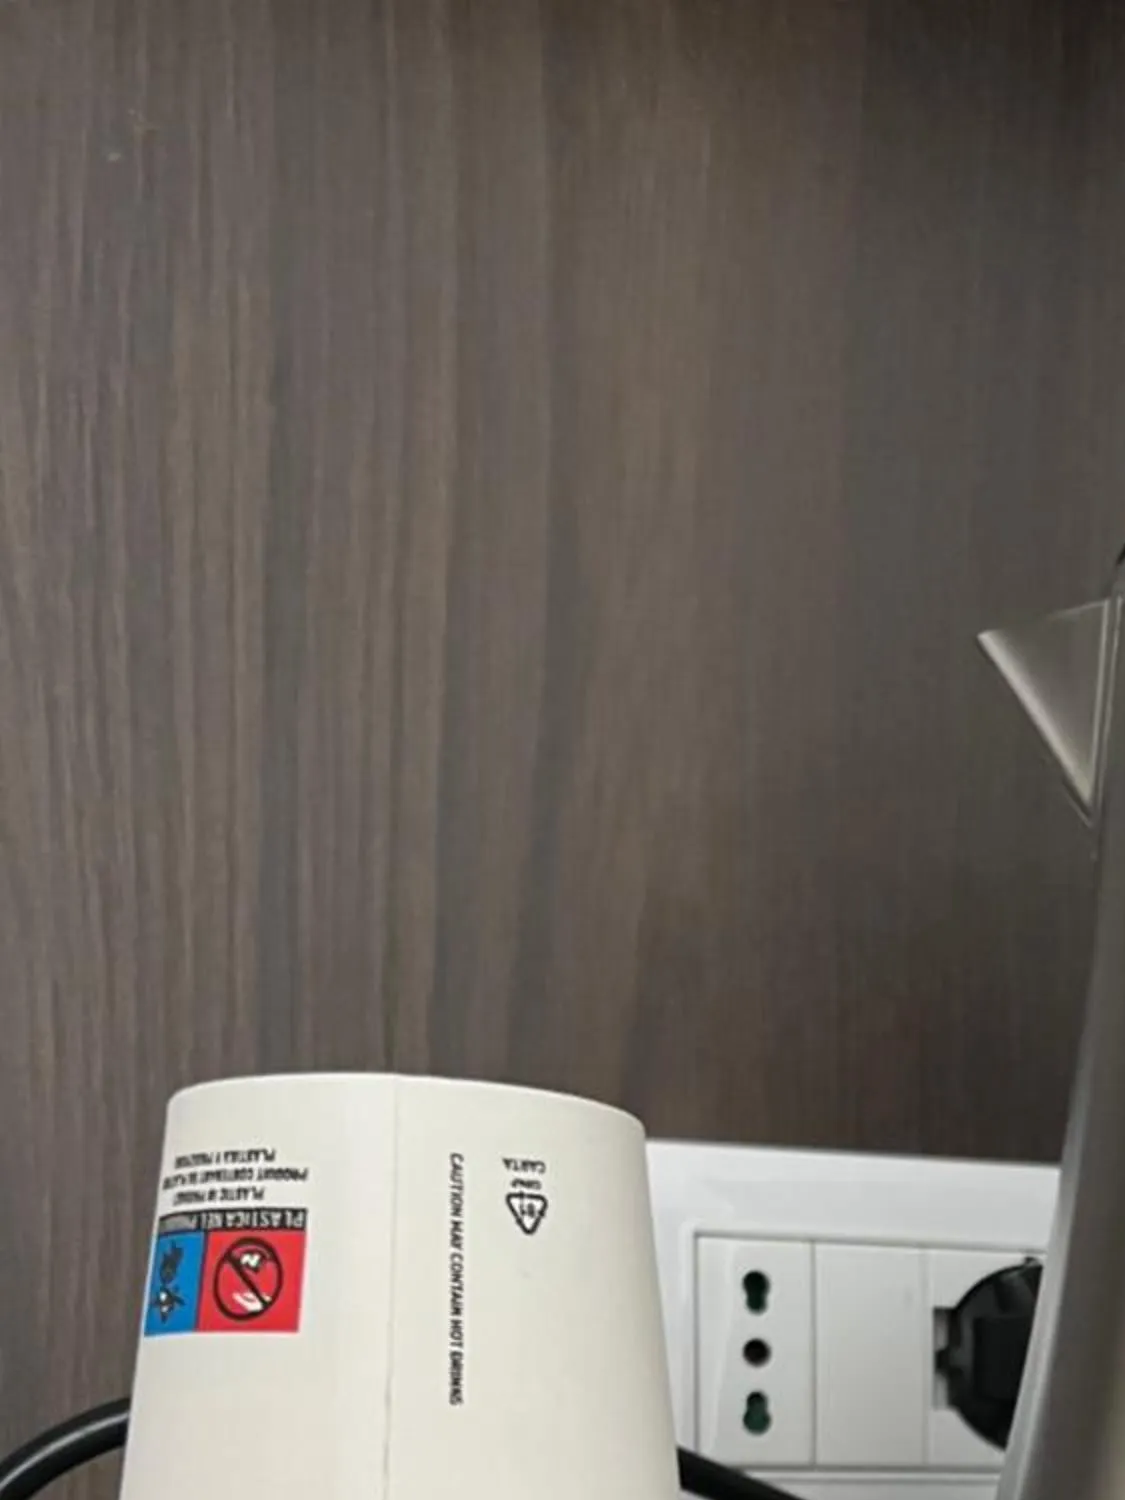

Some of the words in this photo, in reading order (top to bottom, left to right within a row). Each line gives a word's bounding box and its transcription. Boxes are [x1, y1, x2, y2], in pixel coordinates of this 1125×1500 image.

[449, 1152, 464, 1218] CAUTION
[449, 1220, 464, 1250] MAY
[449, 1253, 464, 1316] CONTAIN
[449, 1319, 464, 1348] HOT
